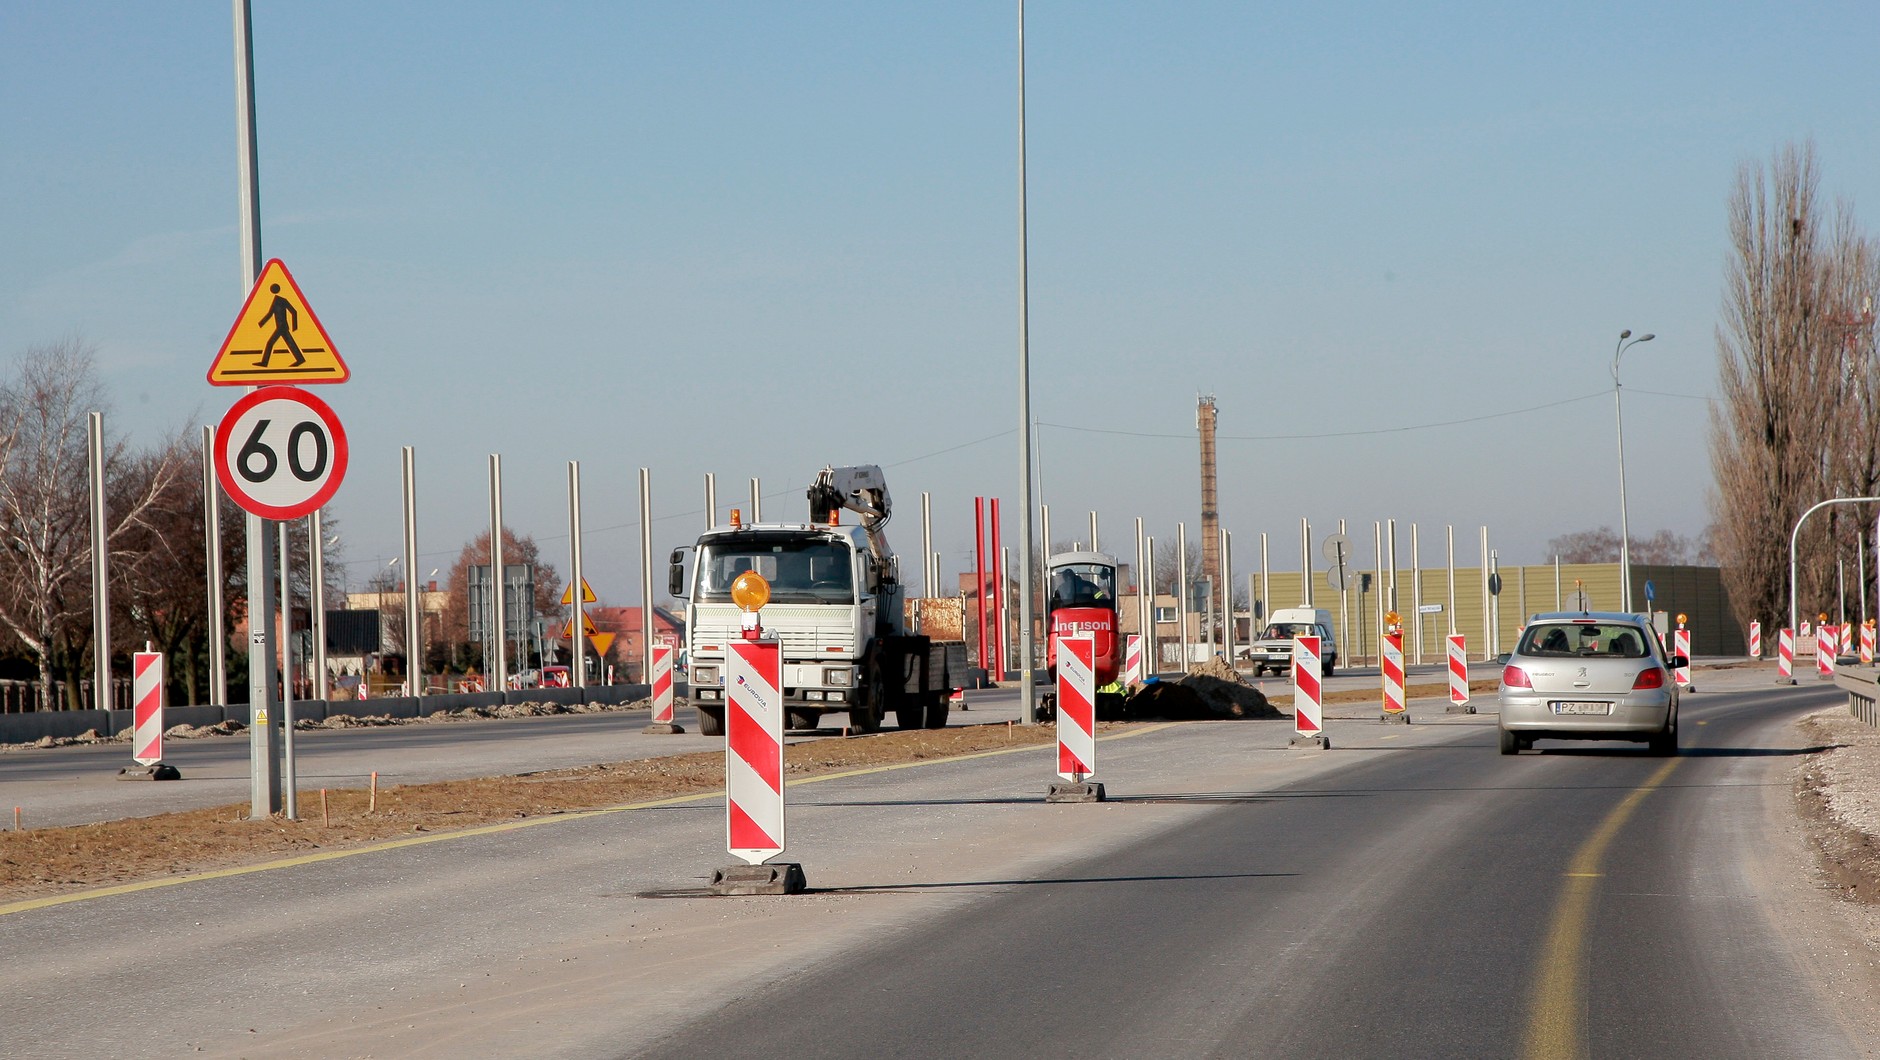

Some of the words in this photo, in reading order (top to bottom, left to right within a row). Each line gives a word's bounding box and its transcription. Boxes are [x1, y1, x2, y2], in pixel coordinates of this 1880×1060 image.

[237, 420, 327, 483] 60
[744, 683, 767, 707] EUROVIA
[1561, 703, 1575, 712] PZ
